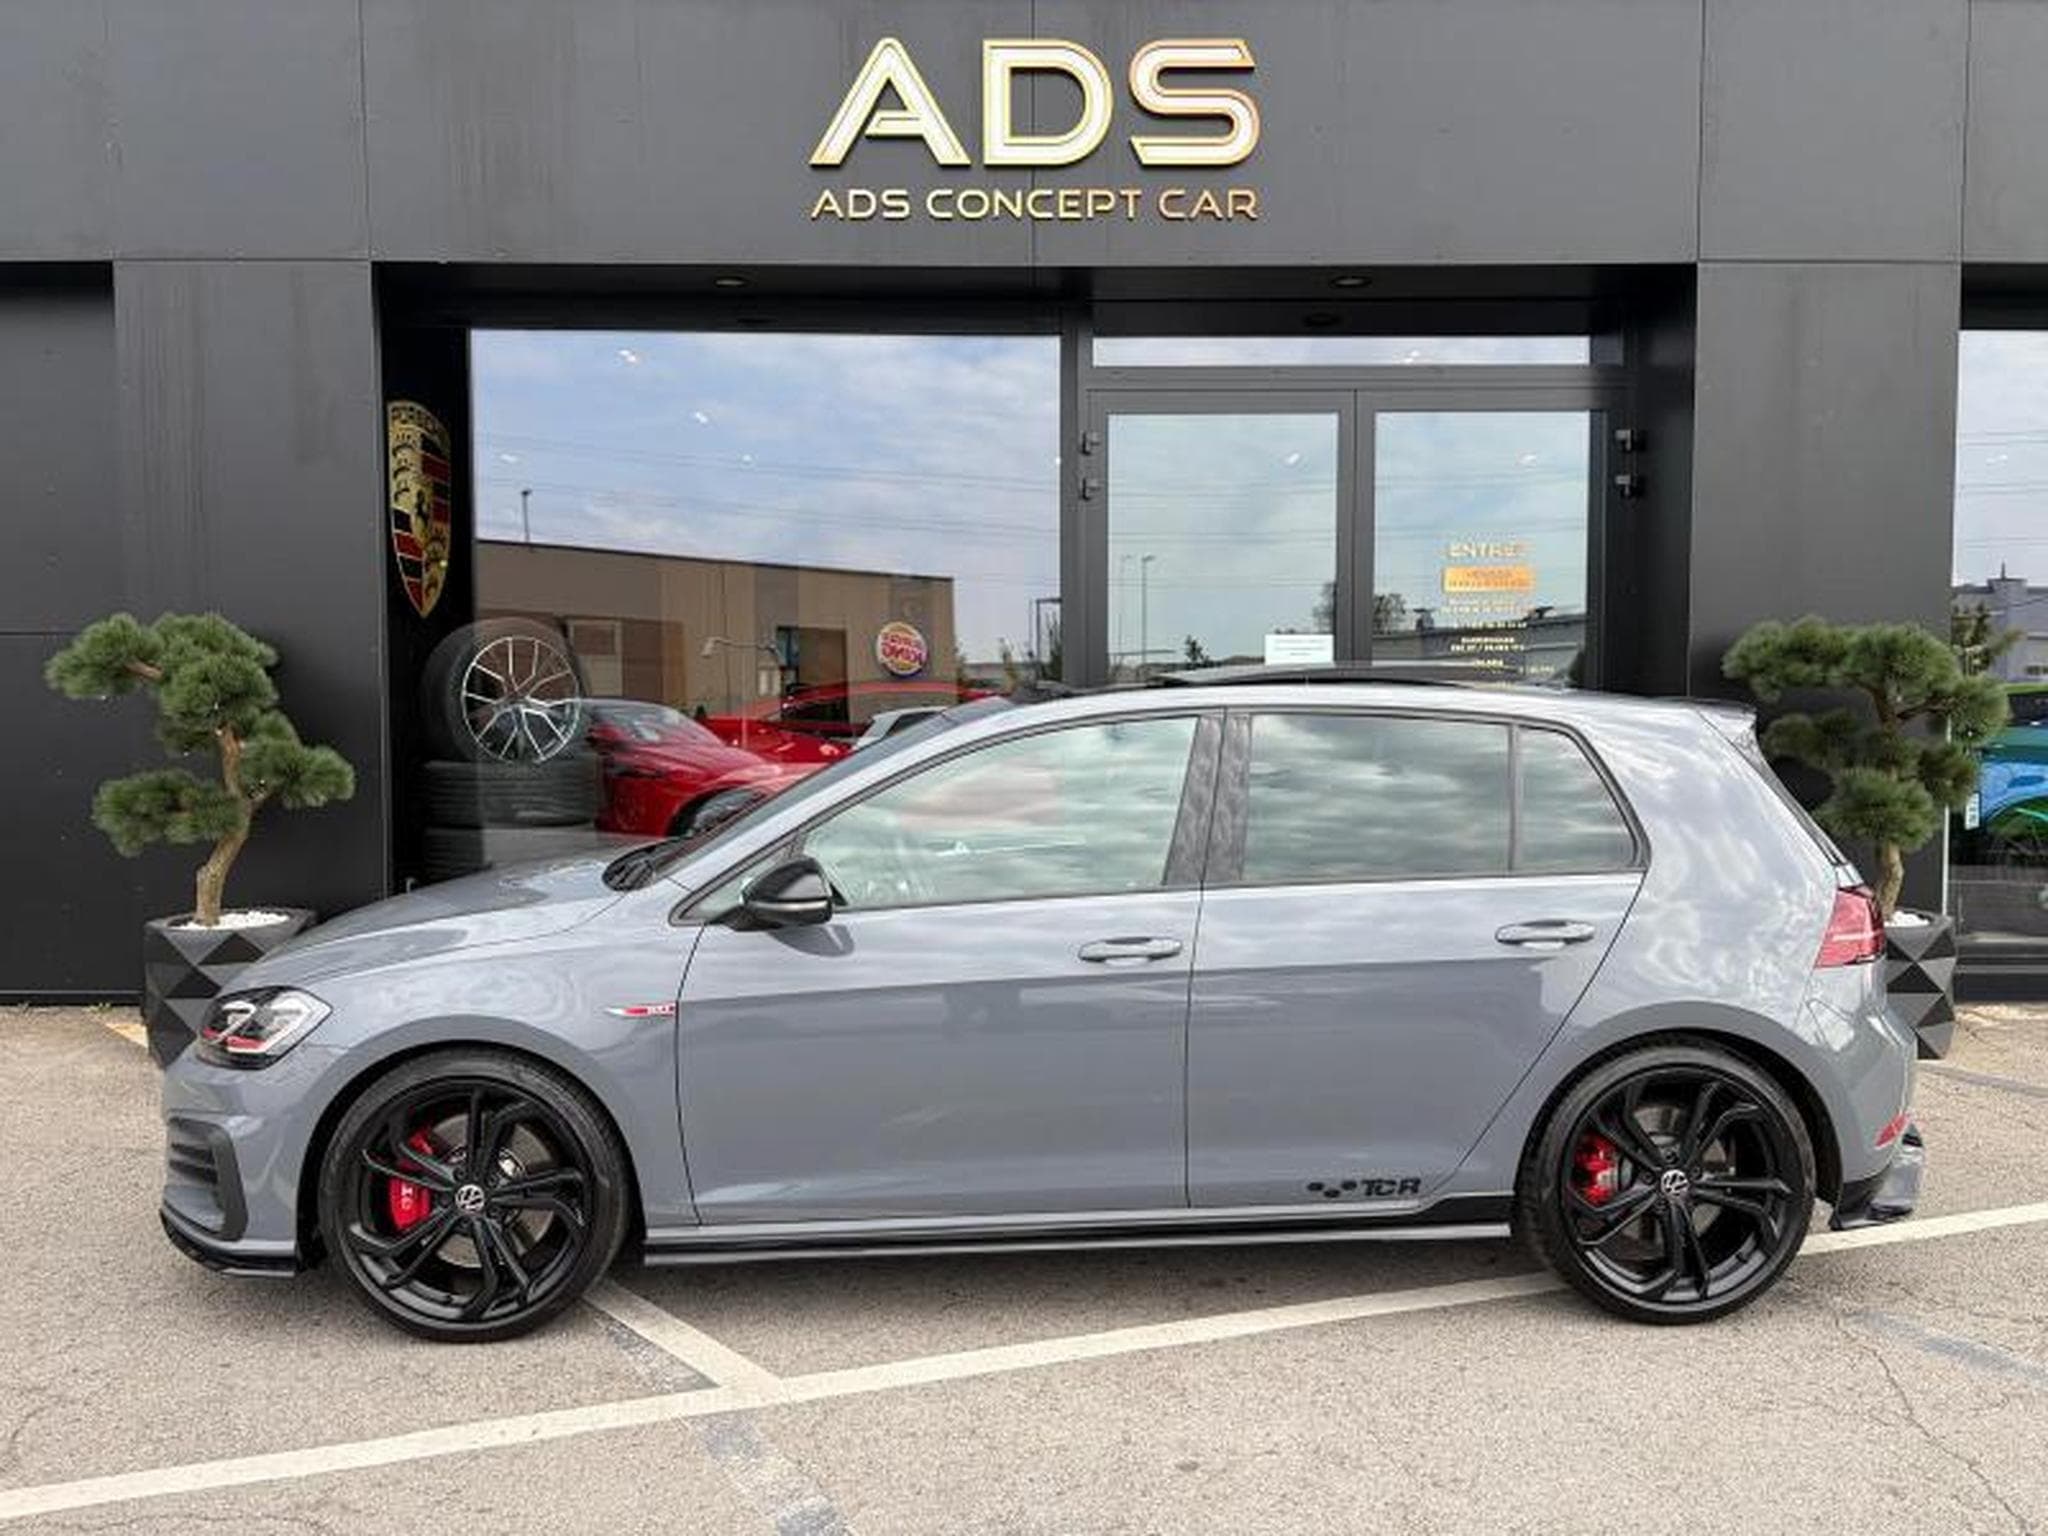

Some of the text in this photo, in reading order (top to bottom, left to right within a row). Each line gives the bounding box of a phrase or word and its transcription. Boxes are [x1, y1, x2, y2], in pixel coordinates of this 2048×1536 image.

[809, 37, 1261, 166] ADS
[811, 189, 1258, 220] ADS CONCEPT CAR
[1360, 1178, 1421, 1197] TCR
